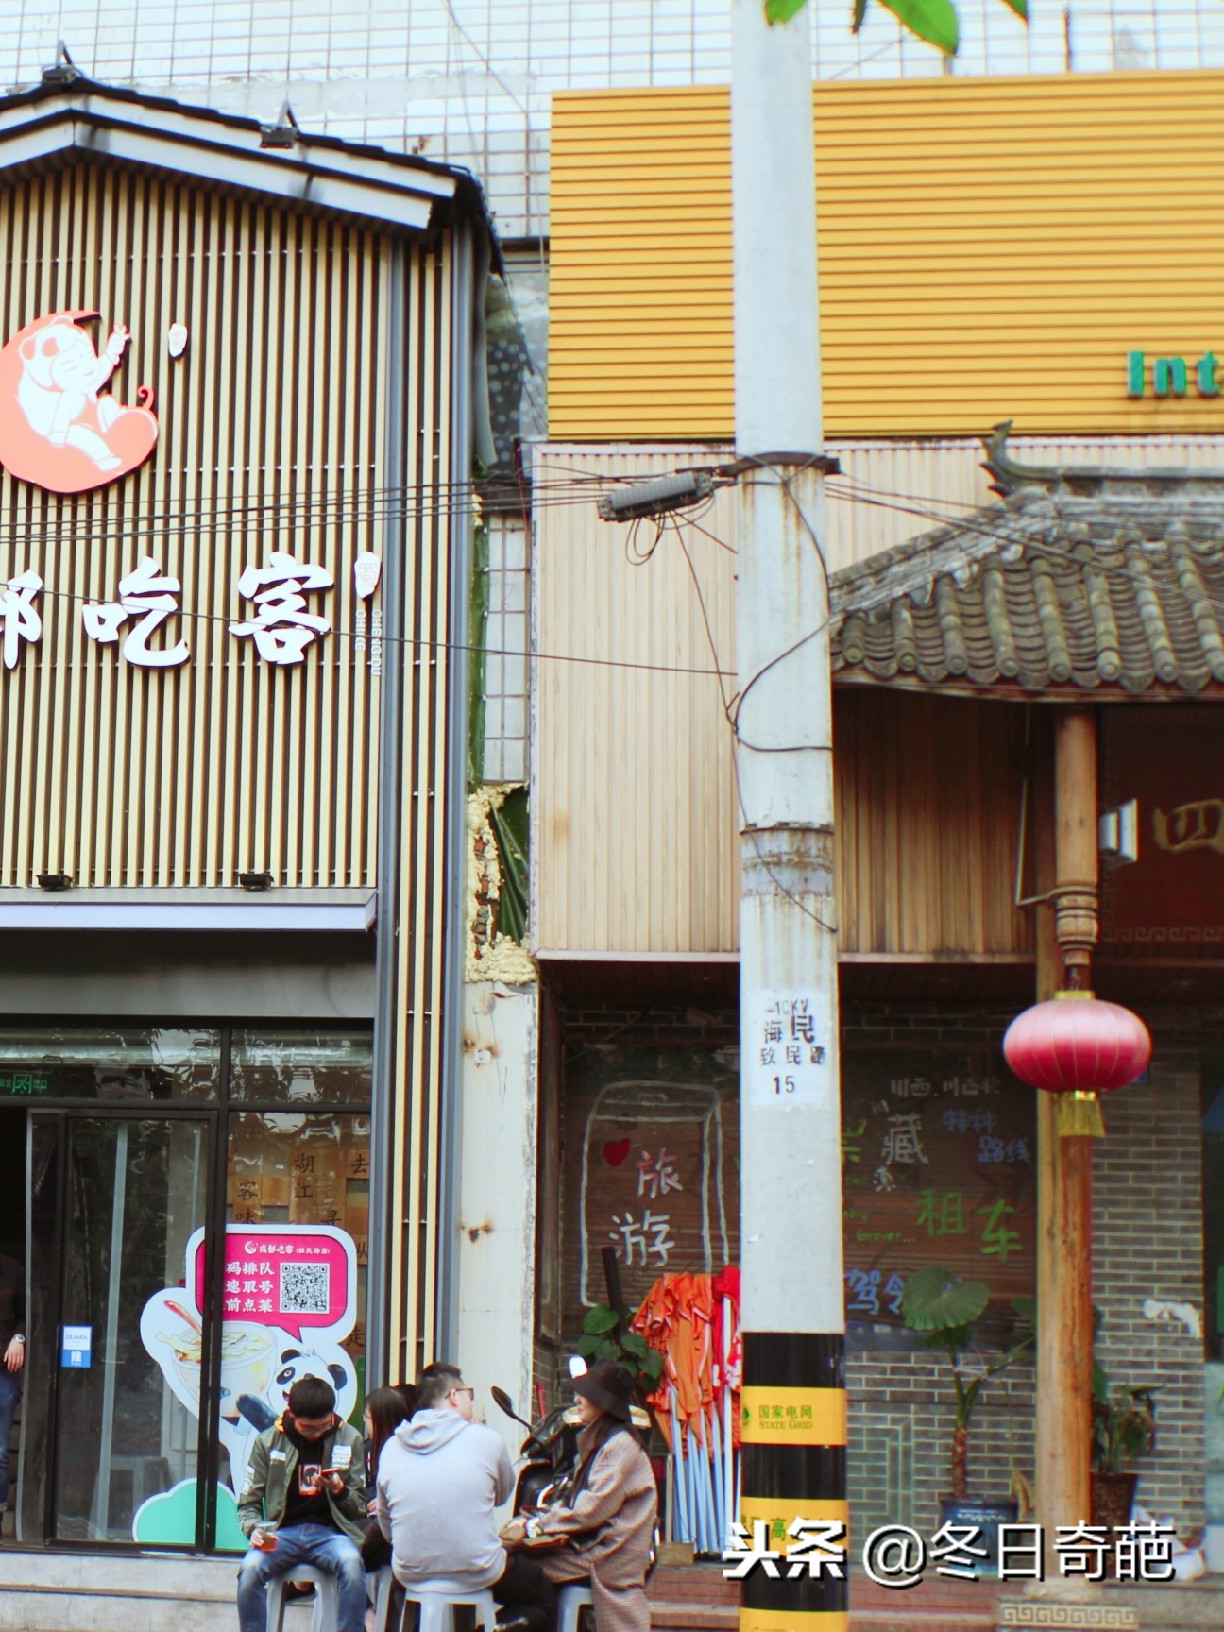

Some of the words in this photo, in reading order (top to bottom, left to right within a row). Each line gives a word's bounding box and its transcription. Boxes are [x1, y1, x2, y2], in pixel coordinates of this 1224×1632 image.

[1127, 350, 1220, 397] Int
[774, 1075, 795, 1095] 15
[881, 1111, 928, 1165] 藏
[915, 1188, 1024, 1263] 租车
[225, 1261, 275, 1275] 码排队
[225, 1280, 274, 1295] 速取号
[225, 1298, 273, 1313] 前点菜
[758, 1404, 813, 1420] 国家电网
